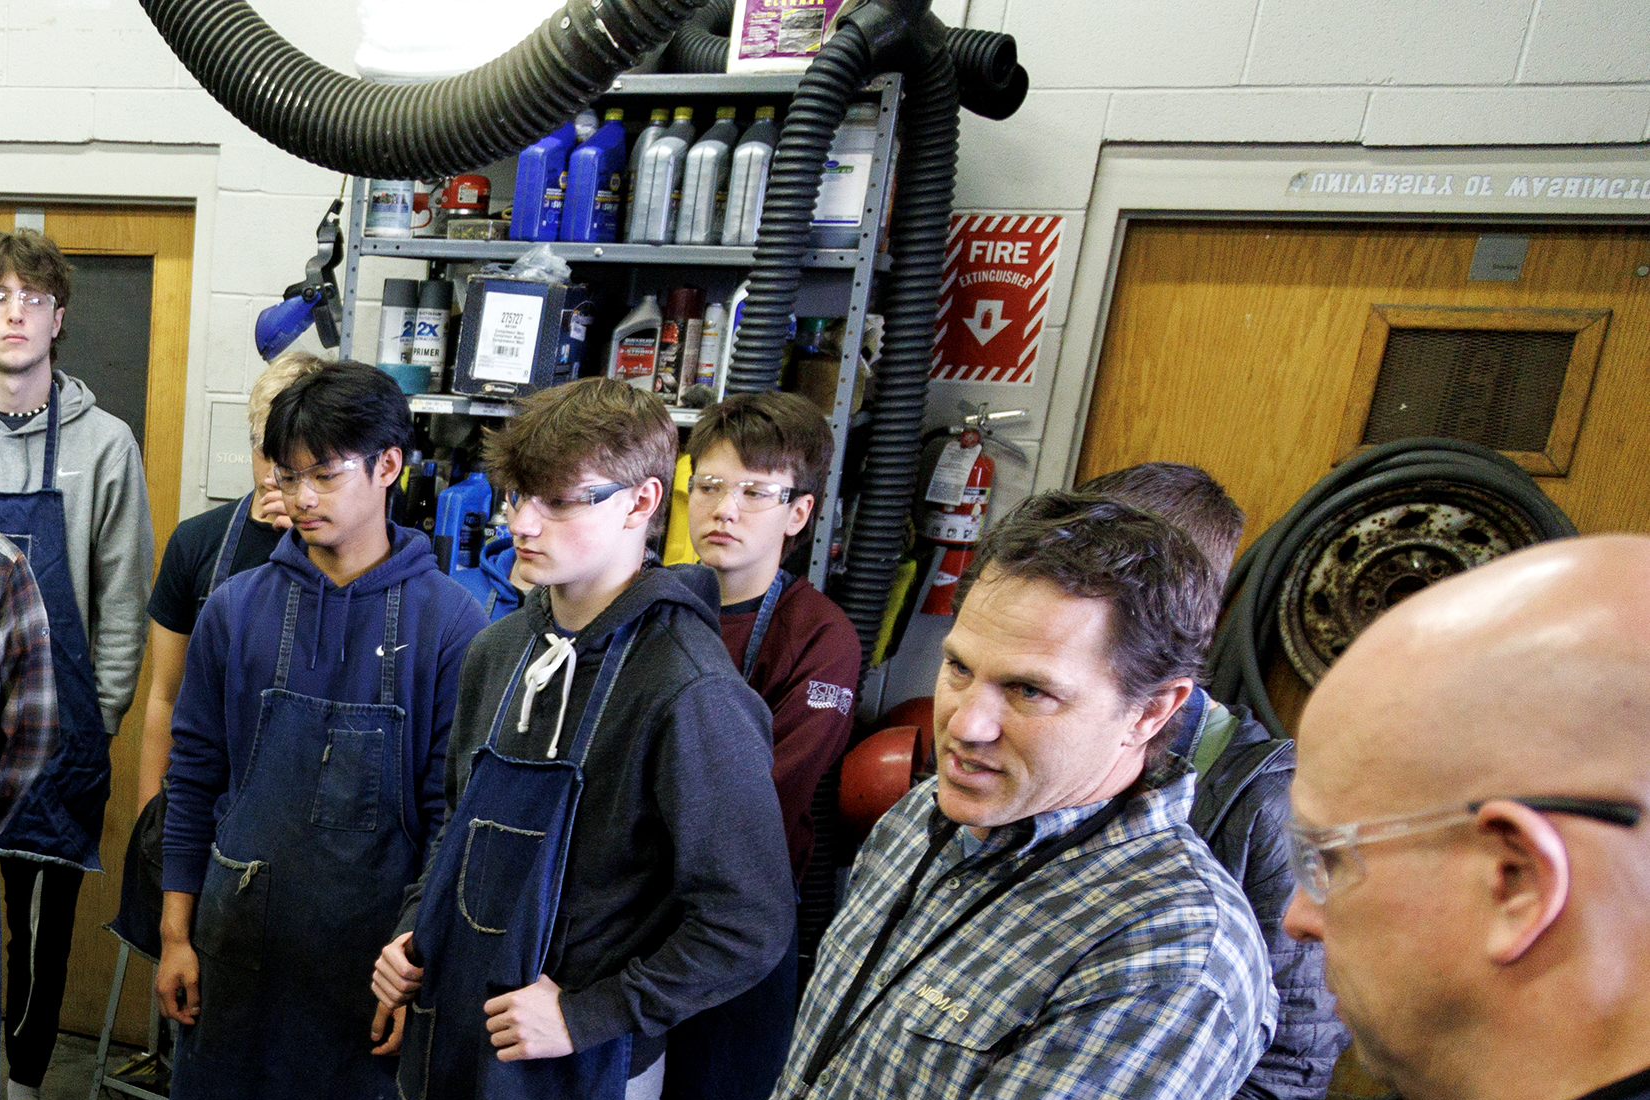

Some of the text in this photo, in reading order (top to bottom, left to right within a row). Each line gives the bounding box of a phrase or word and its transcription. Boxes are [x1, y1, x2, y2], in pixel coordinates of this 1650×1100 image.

[969, 241, 1032, 264] FIRE
[959, 270, 1033, 290] EXTINGUISHER
[501, 311, 524, 325] 275727
[417, 322, 439, 337] 2X
[414, 347, 440, 357] PRIMER
[216, 452, 253, 464] STORA
[916, 984, 969, 1022] NOMAD
